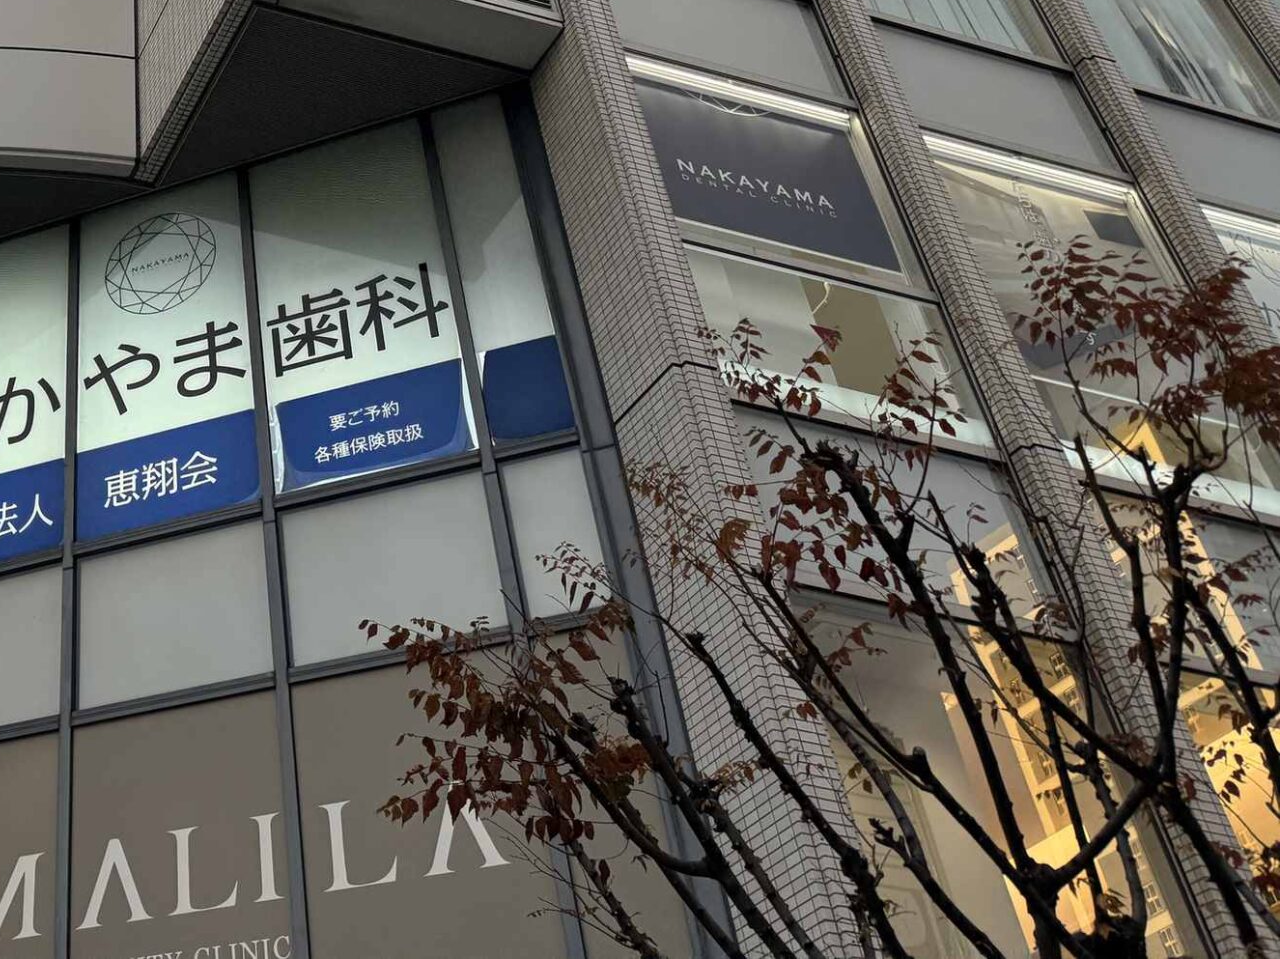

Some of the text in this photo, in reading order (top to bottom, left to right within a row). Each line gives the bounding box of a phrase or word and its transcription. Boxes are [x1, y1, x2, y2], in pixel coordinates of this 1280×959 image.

[675, 158, 835, 209] NAKAYAMA
[681, 173, 838, 218] DENTAL CLINIC
[131, 252, 190, 273] NAKAYAMA
[328, 400, 400, 432] 要ご予約
[314, 423, 424, 463] 各種保険取扱
[103, 450, 218, 508] 恵翔会
